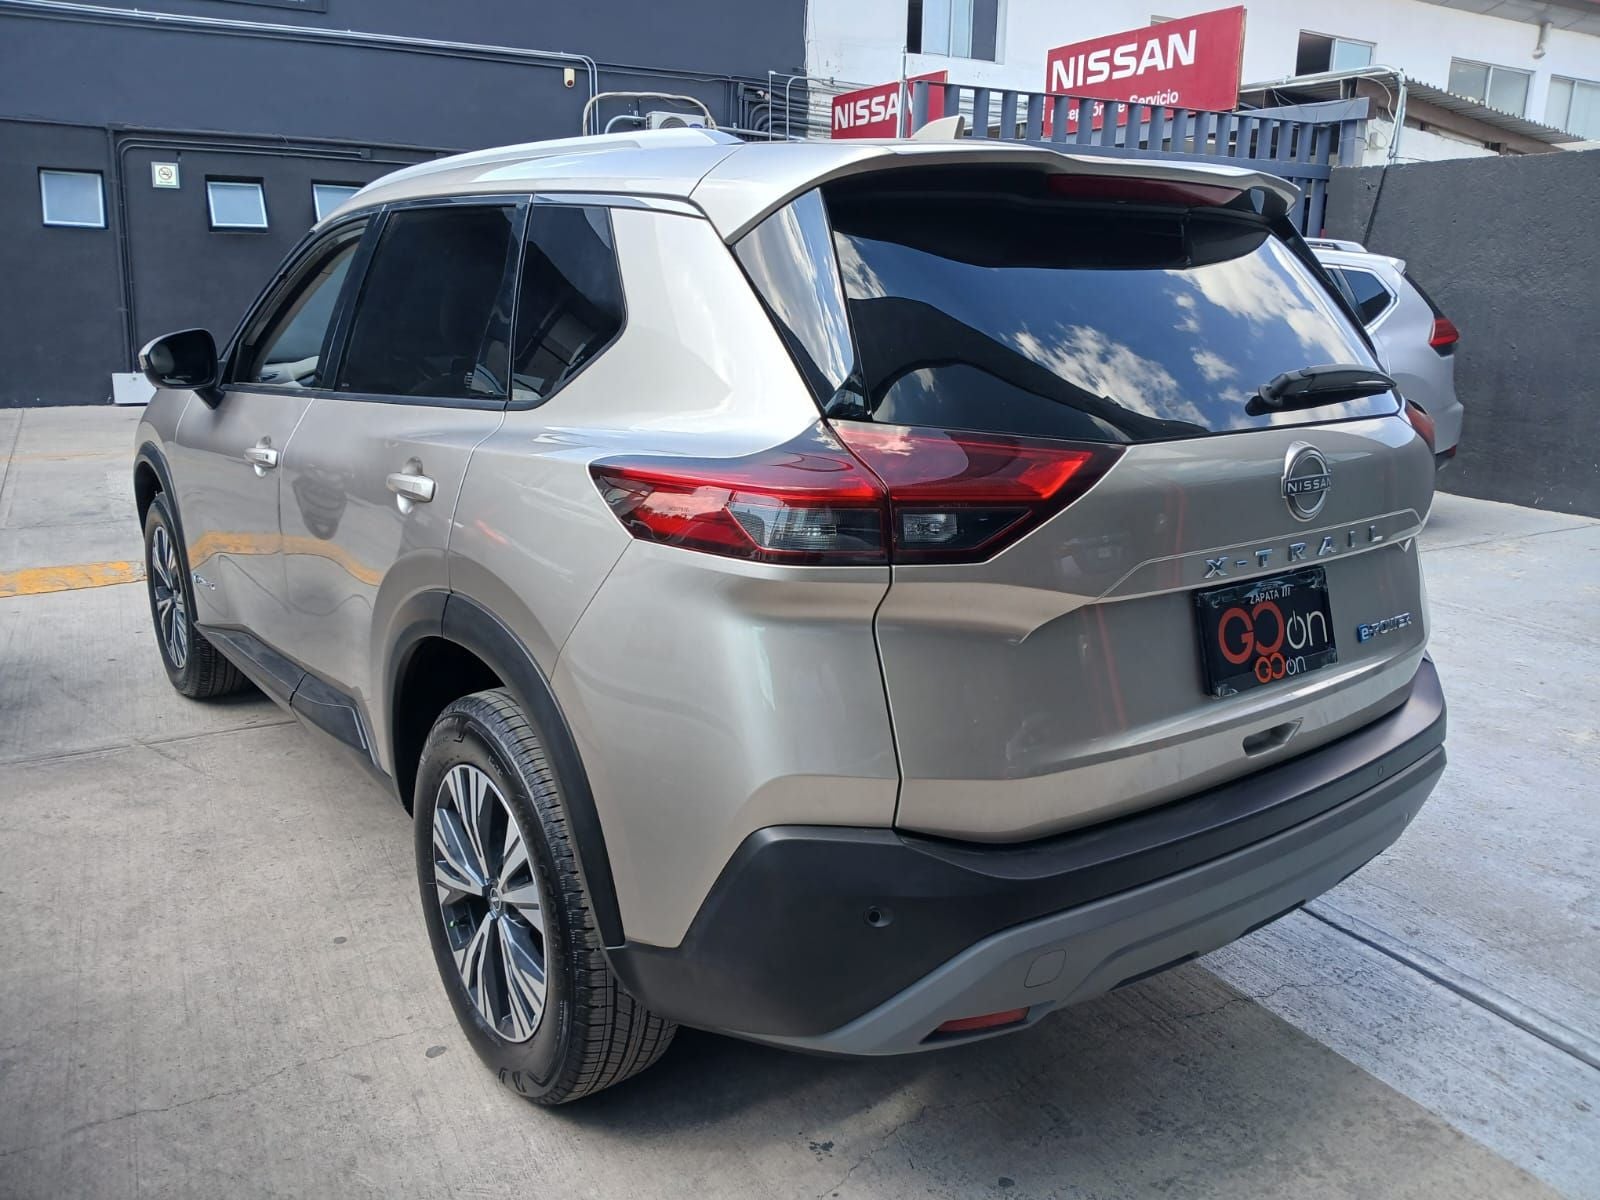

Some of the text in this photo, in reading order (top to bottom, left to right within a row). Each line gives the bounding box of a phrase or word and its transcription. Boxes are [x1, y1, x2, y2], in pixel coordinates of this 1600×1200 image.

[1051, 29, 1197, 92] NISSAN
[1204, 525, 1383, 578] X-TRAIL
[1250, 590, 1280, 604] ZAPATA
